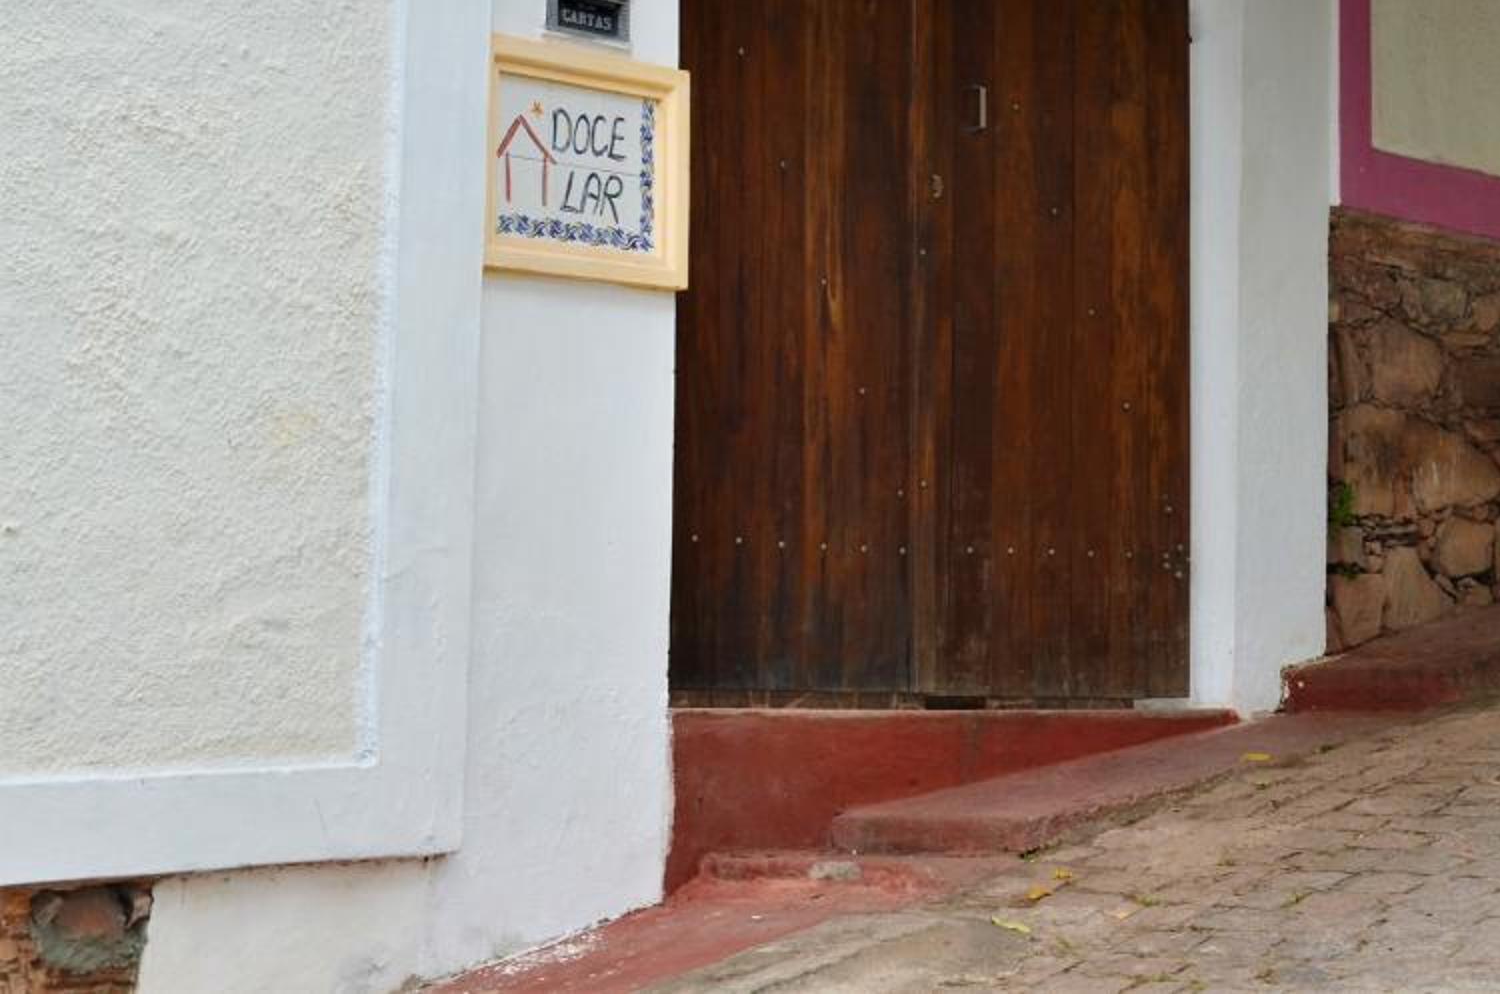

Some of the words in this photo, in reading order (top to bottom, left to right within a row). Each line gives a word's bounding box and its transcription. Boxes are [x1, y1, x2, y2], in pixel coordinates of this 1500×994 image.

[561, 8, 613, 30] CARTAS
[552, 108, 627, 161] DOCE
[560, 171, 623, 224] LAR
